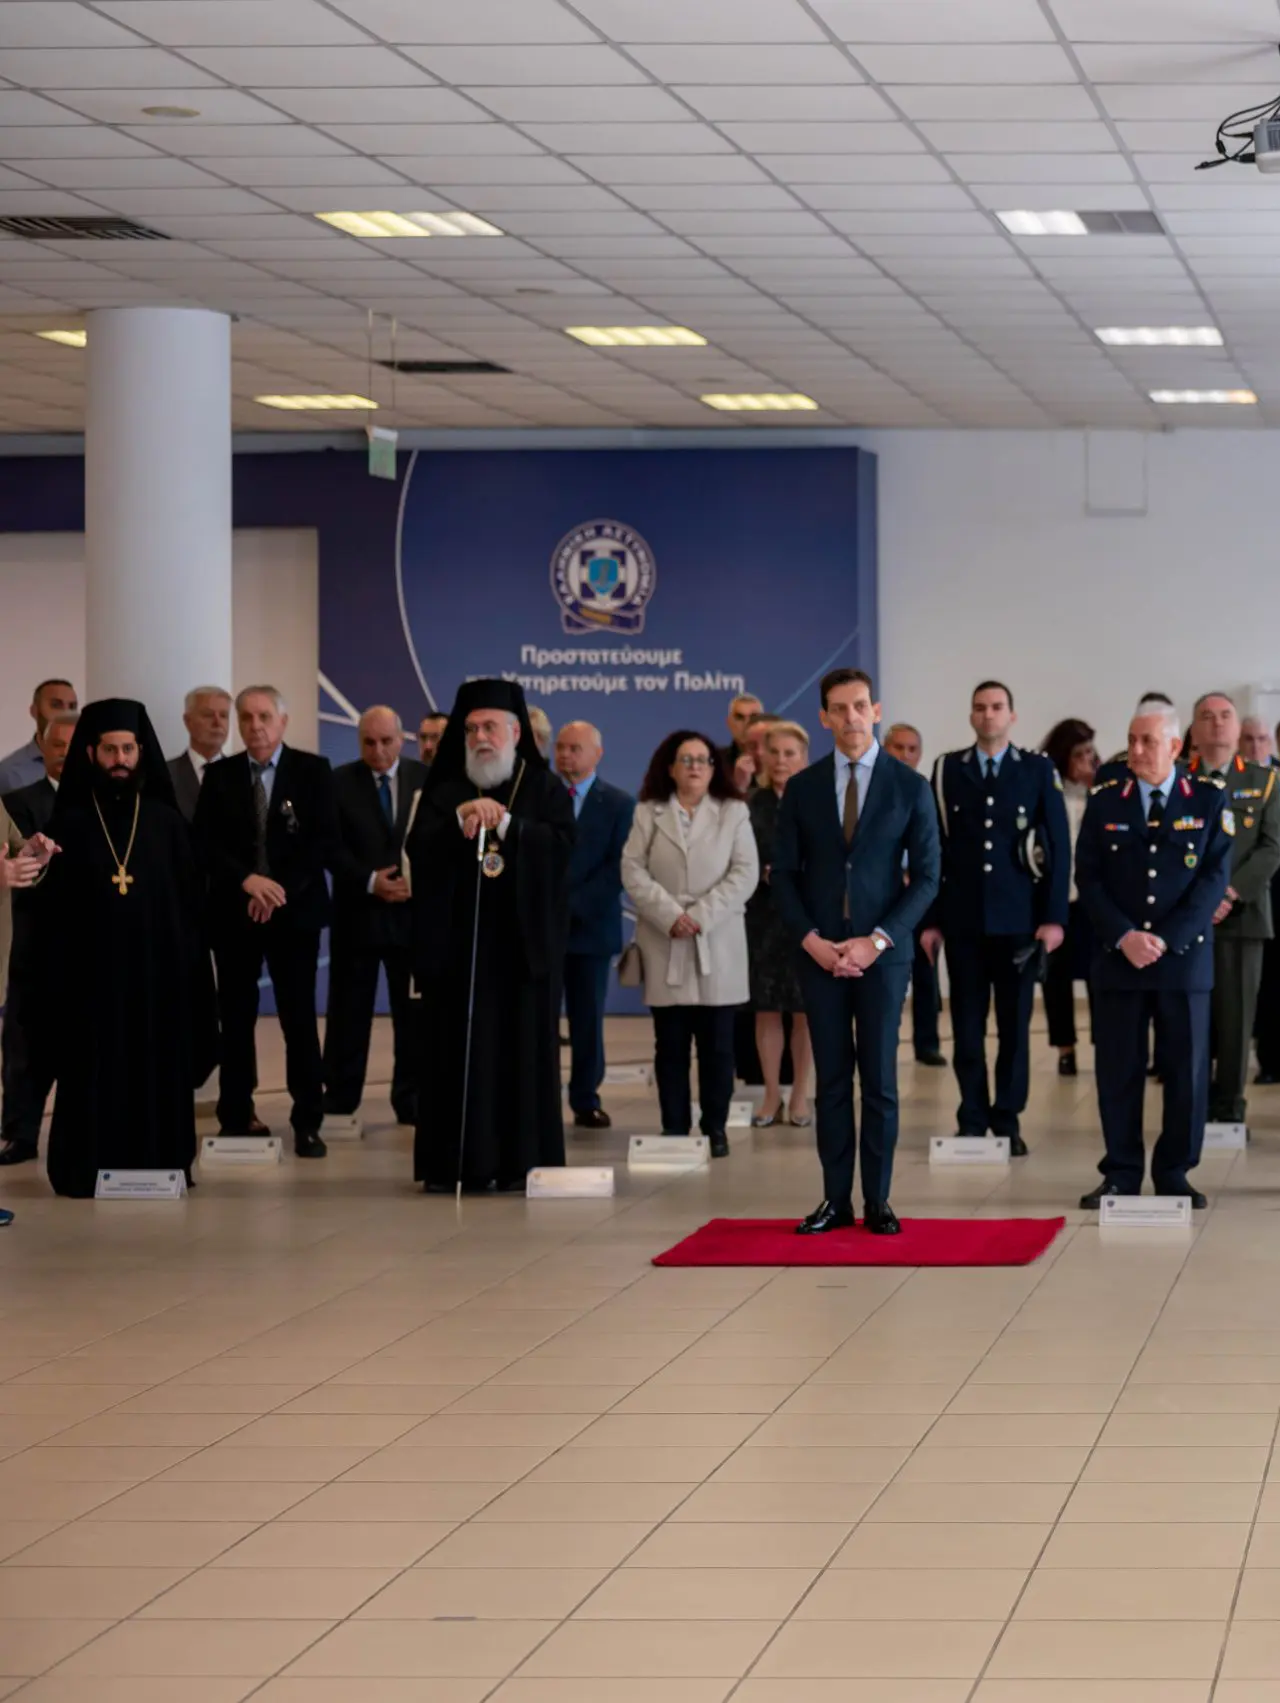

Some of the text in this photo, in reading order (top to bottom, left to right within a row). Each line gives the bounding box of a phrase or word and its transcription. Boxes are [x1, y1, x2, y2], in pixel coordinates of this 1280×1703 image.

[521, 643, 684, 669] Προστατεύουμε
[635, 674, 669, 692] τον
[674, 669, 745, 695] Πολίτη
